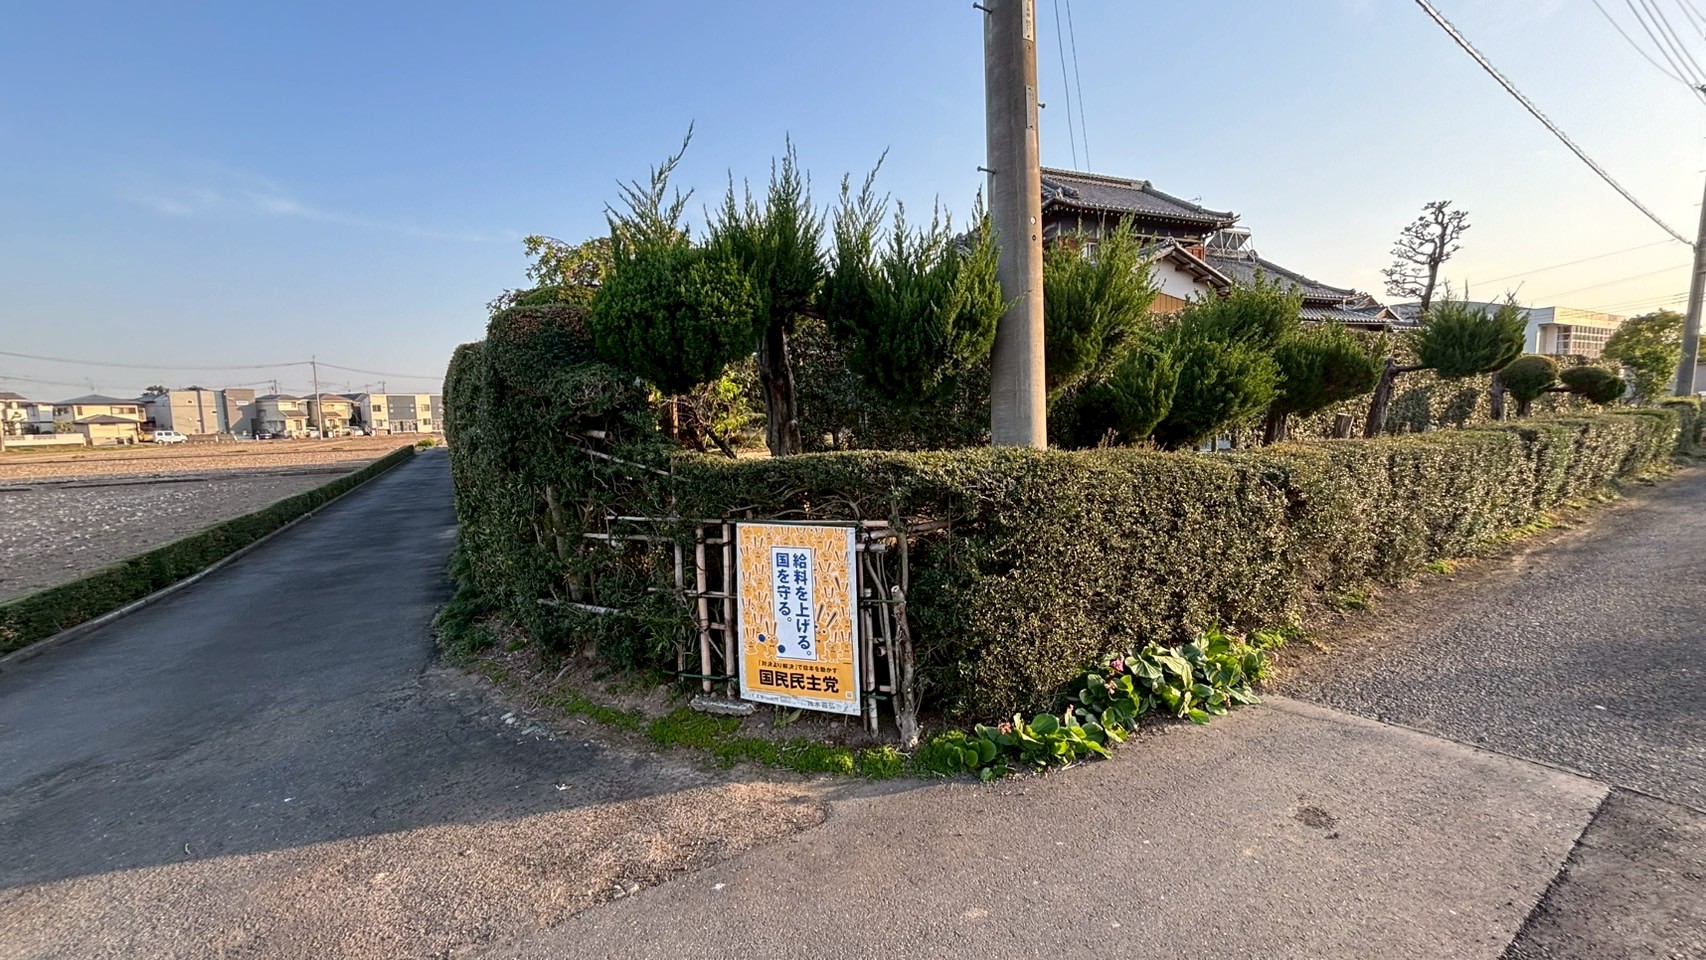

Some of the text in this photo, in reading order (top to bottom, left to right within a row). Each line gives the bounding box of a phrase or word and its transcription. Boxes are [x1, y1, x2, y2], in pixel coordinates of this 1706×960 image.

[775, 552, 792, 623] 国を守る。
[792, 553, 812, 656] 給料を上げる。
[759, 668, 839, 693] 国民民主党
